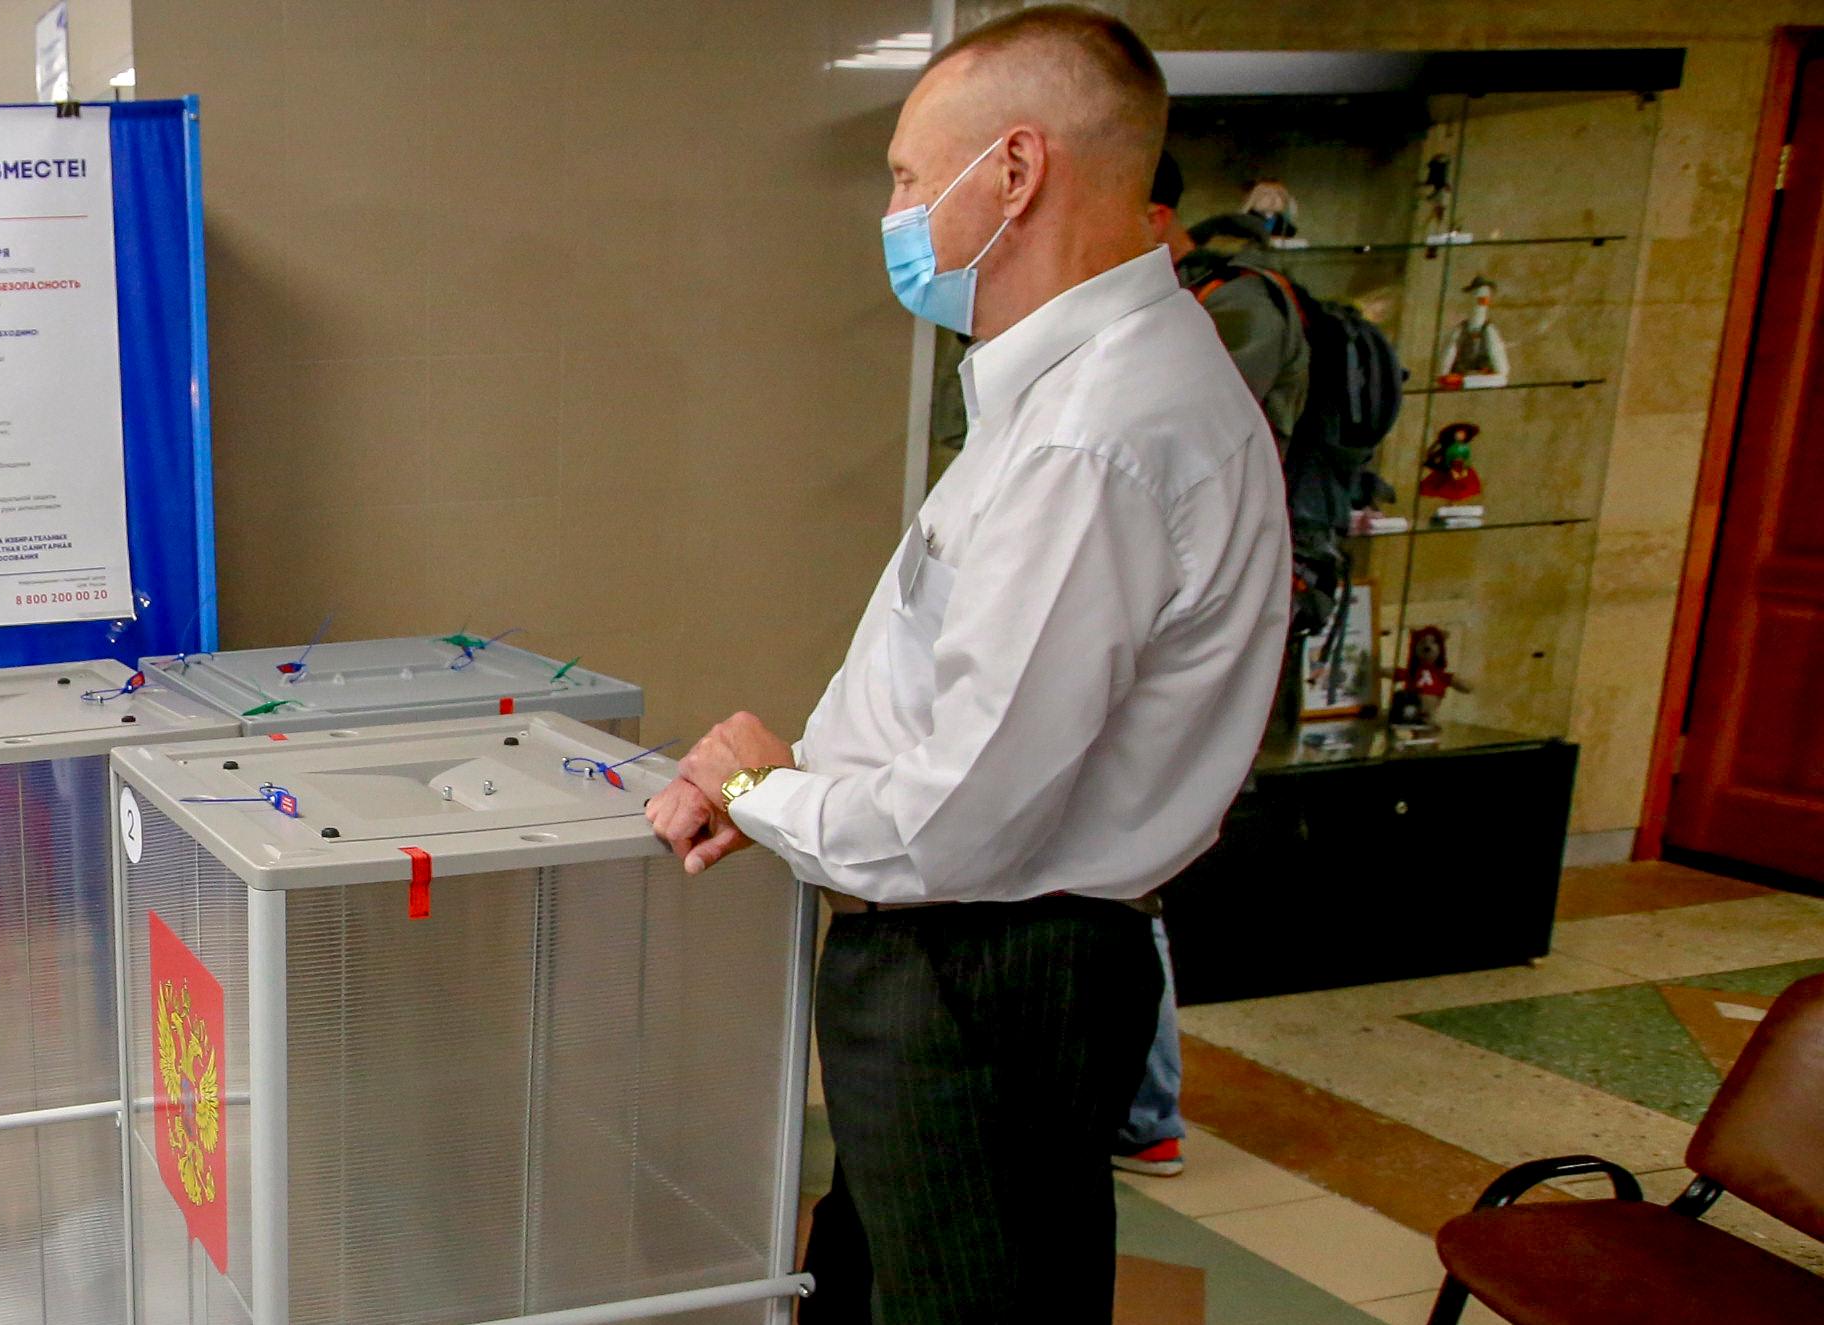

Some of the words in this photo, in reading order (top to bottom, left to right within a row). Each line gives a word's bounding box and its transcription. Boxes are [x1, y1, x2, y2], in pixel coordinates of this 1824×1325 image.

[16, 594, 23, 606] 8
[26, 593, 48, 605] 800
[51, 592, 73, 603] 200
[76, 590, 90, 601] 00
[93, 589, 108, 600] 20
[127, 809, 136, 841] 2
